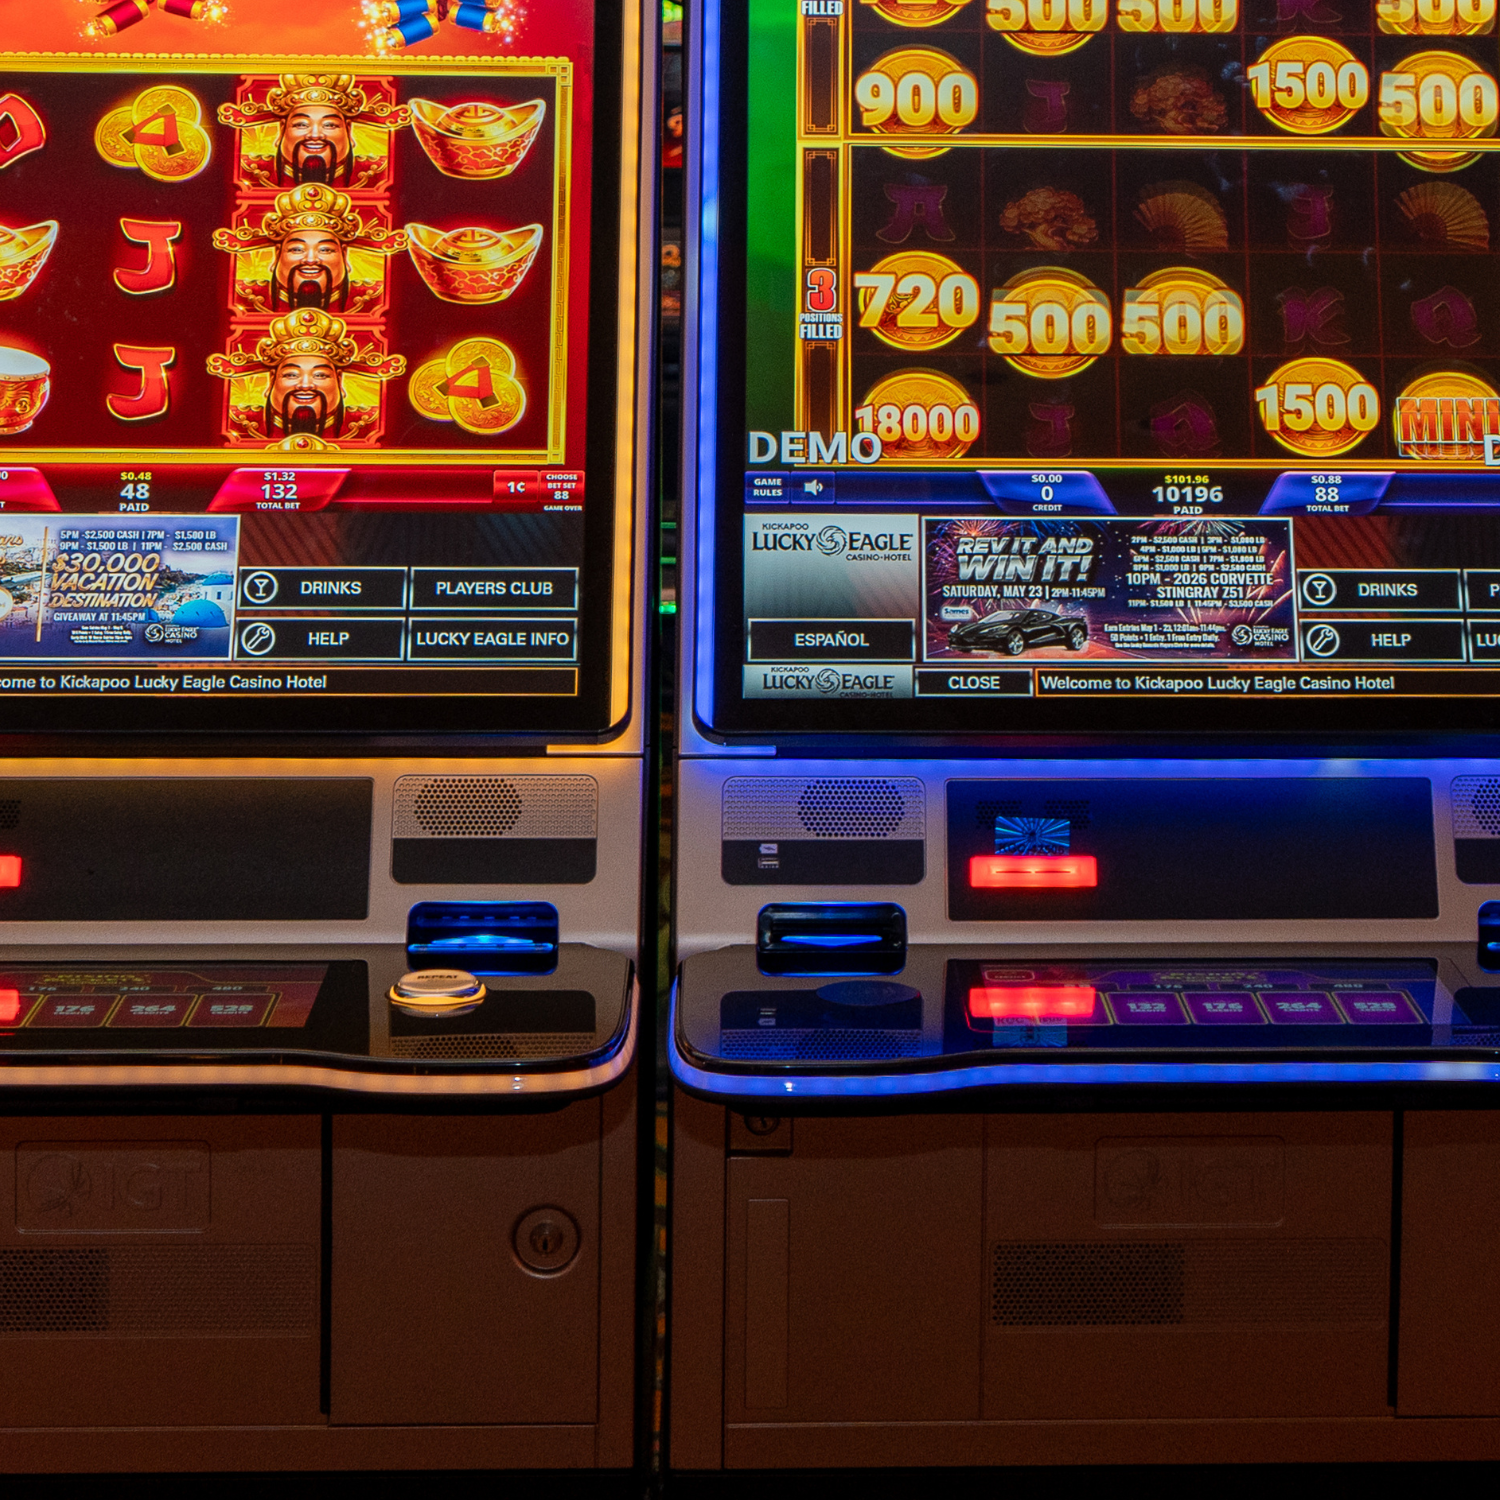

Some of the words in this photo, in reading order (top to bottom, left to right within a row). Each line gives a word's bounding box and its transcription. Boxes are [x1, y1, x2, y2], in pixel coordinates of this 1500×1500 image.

[801, 0, 844, 17] FILLED
[1248, 62, 1369, 112] 1500
[855, 72, 979, 128] 900
[113, 219, 183, 297] J
[806, 268, 836, 312] 3
[853, 273, 980, 328] 720
[799, 323, 843, 341] FILLED
[106, 342, 178, 422] J
[1256, 382, 1380, 432] 1500
[855, 402, 981, 443] 18000
[748, 430, 883, 465] DEMO
[120, 471, 152, 482] $0.48
[263, 471, 296, 482] $1.32
[753, 477, 782, 486] GAME
[1031, 473, 1063, 484] $0.00
[1164, 474, 1209, 485] $101.96
[1311, 474, 1342, 485] $0.88
[120, 483, 150, 500] 48
[260, 483, 298, 500] 132
[753, 488, 783, 497] RULES
[1041, 486, 1053, 501] 0
[1151, 485, 1223, 503] 10196
[1314, 486, 1340, 502] 88
[119, 502, 150, 512] PAID
[256, 502, 284, 510] TOTAL
[286, 502, 301, 510] BET
[1032, 503, 1062, 512] CREDIT
[1173, 505, 1203, 515] PAID
[1306, 504, 1332, 513] TOTAL
[1334, 504, 1350, 513] BET
[762, 522, 809, 530] KICKAPOO
[752, 532, 815, 551] LUCKY
[849, 532, 912, 551] EAGLE
[956, 537, 1010, 554] REV
[1010, 537, 1038, 554] IT
[1038, 537, 1094, 554] AND
[51, 553, 160, 573] $30,000
[958, 555, 1039, 582] WIN
[1041, 555, 1094, 582] IT!
[50, 573, 159, 591] VACATION
[1125, 573, 1161, 585] 10PM
[1173, 573, 1207, 585] 2026
[1210, 573, 1274, 585] CORVETTE
[300, 581, 362, 595] DRINKS
[435, 582, 506, 595] PLAYERS
[509, 582, 553, 595] CLUB
[942, 585, 1001, 598] SATURDAY,
[1003, 585, 1026, 597] MAY
[1028, 585, 1043, 597] 23
[1157, 586, 1218, 598] STINGRAY
[1222, 586, 1244, 598] Z51
[1358, 583, 1418, 597] DRINKS
[48, 592, 158, 608] DESTINATION
[54, 612, 97, 621] GIVEAWAY
[98, 612, 109, 621] AT
[111, 612, 145, 621] 11:45PM
[308, 632, 349, 645] HELP
[416, 632, 470, 645] LUCKY
[473, 632, 526, 645] EAGLE
[530, 632, 569, 645] INFO
[795, 630, 869, 647] ESPAÑOL
[1371, 633, 1411, 647] HELP
[39, 676, 55, 689] to
[60, 675, 130, 692] Kickapoo
[134, 675, 178, 692] Lucky
[182, 675, 225, 692] Eagle
[229, 675, 281, 689] Casino
[286, 675, 327, 689] Hotel
[948, 675, 1000, 690] CLOSE
[1041, 676, 1112, 690] Welcome
[1115, 677, 1131, 690] to
[1135, 676, 1203, 693] Kickapoo
[1208, 676, 1250, 693] Lucky
[1254, 676, 1296, 693] Eagle
[1299, 676, 1351, 690] Casino
[1355, 676, 1395, 690] Hotel
